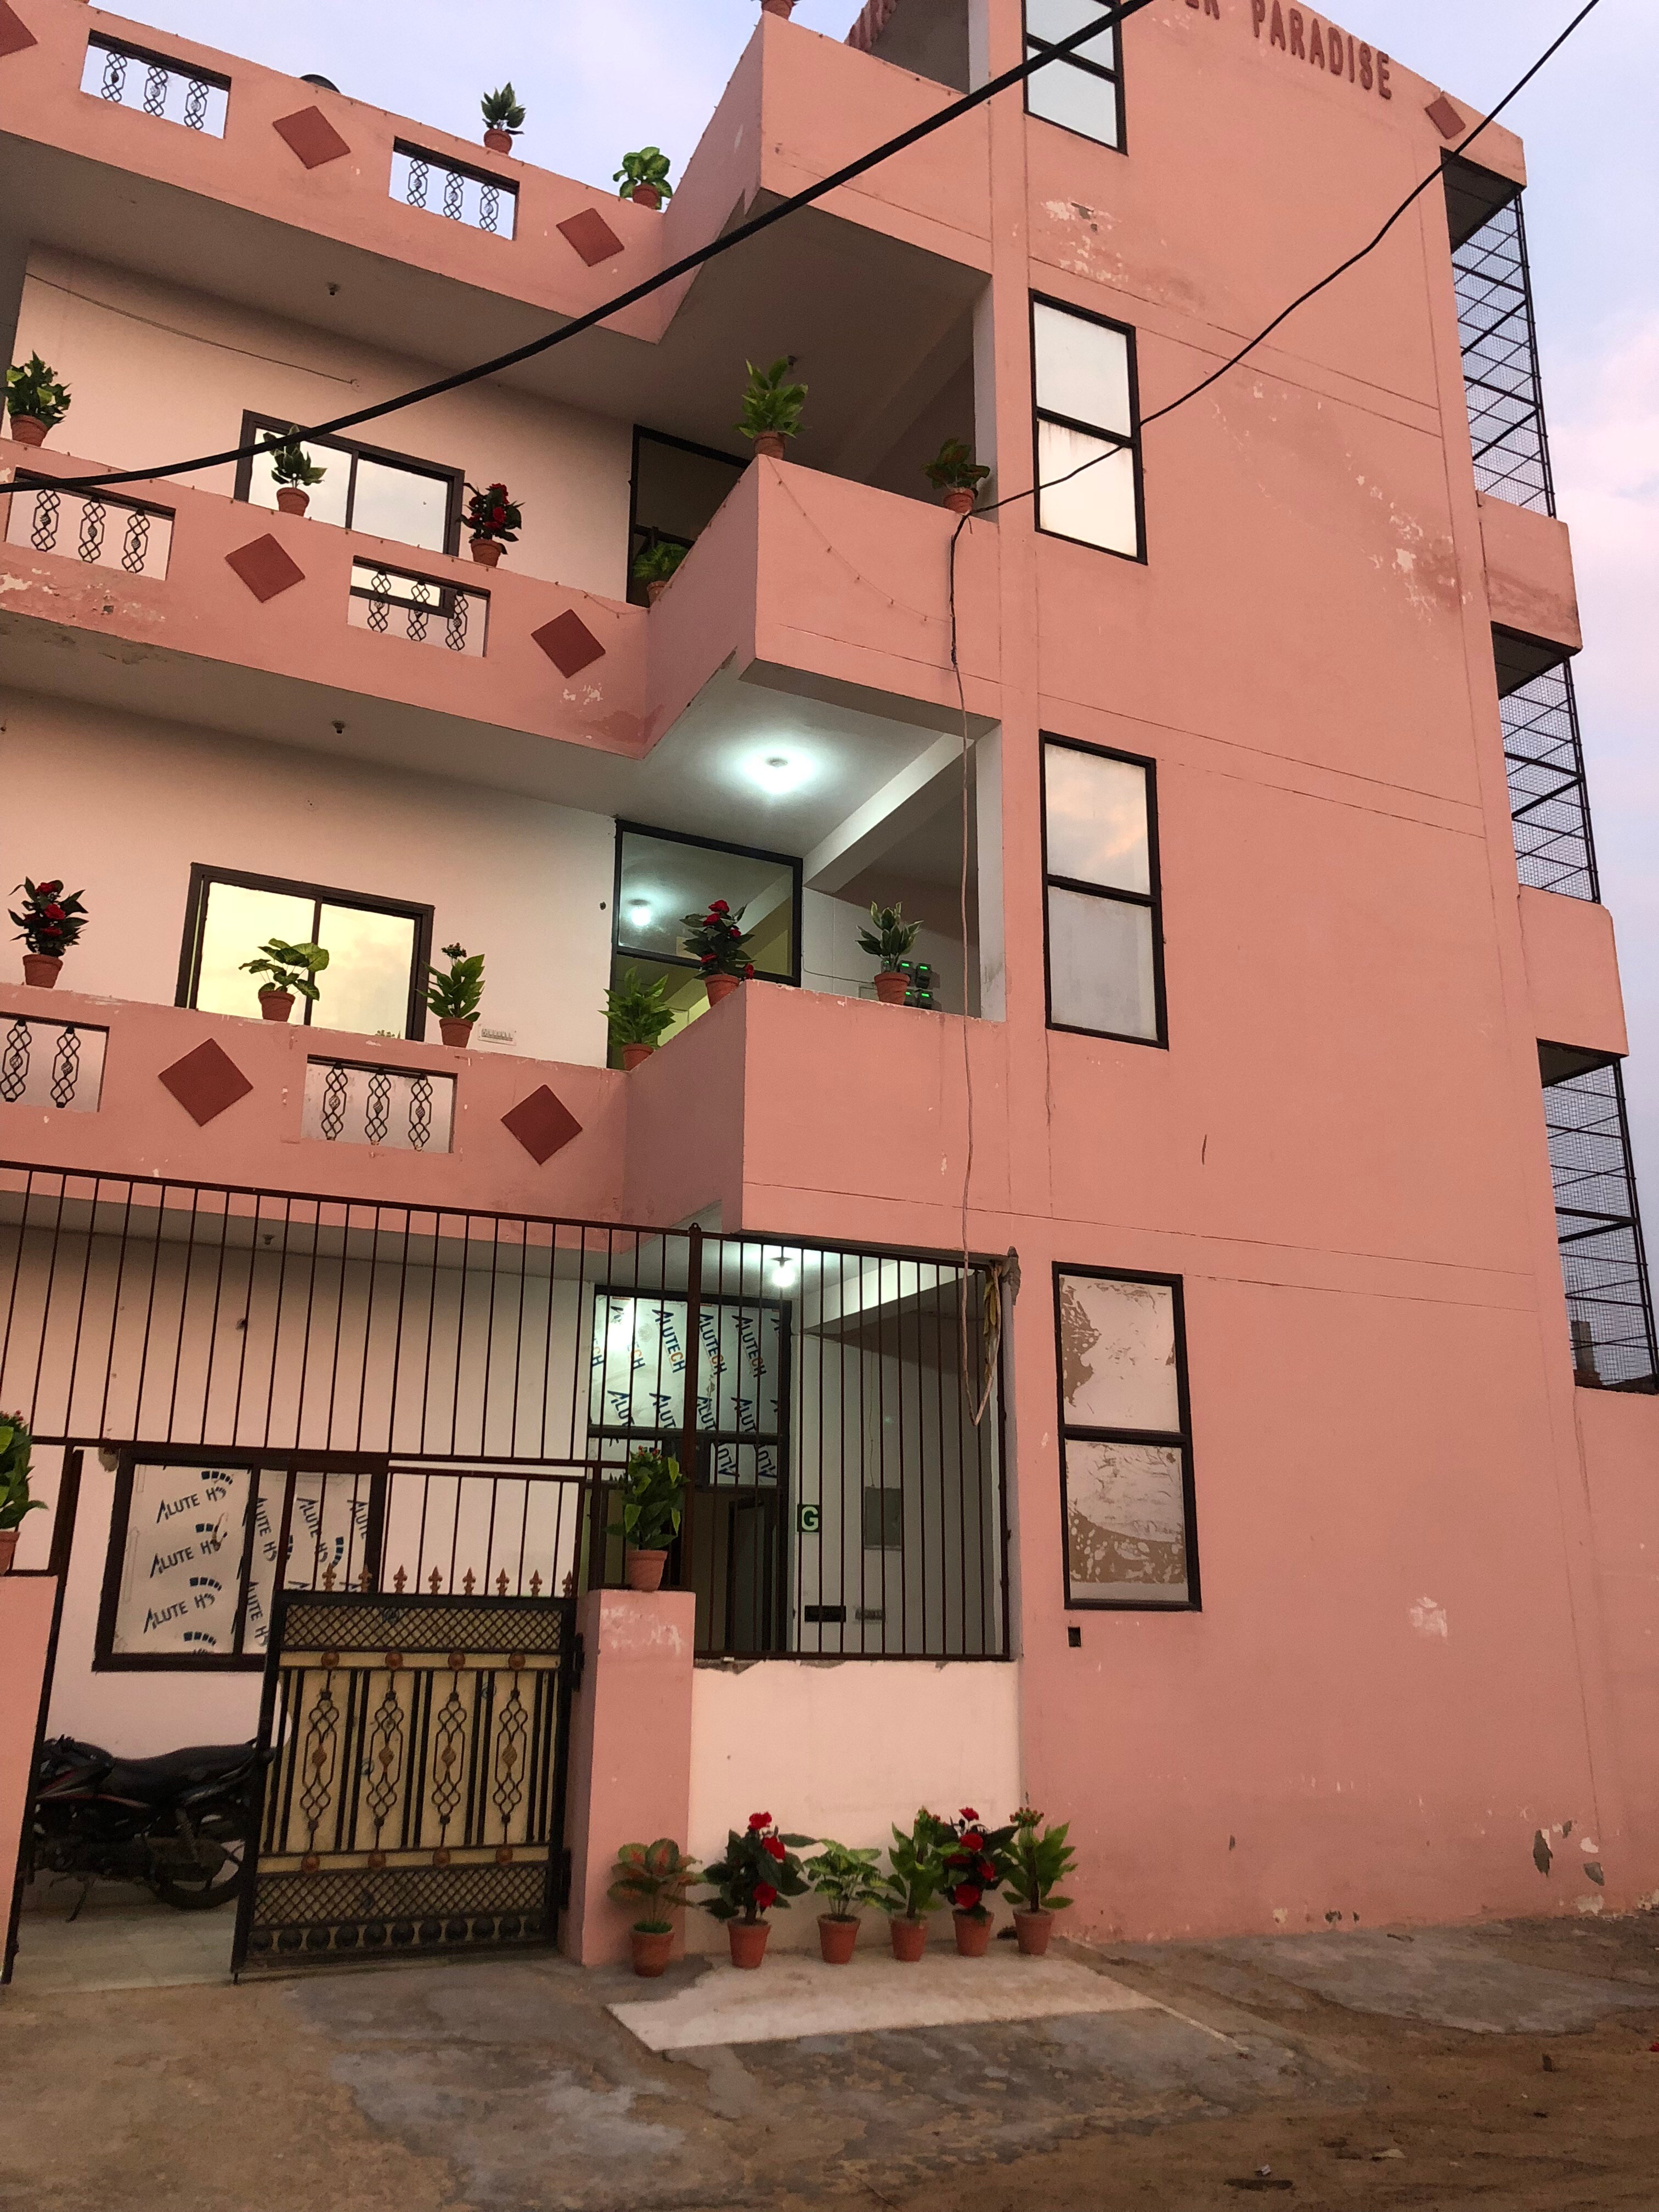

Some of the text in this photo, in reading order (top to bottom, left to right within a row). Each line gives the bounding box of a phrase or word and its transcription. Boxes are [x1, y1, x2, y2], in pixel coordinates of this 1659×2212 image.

[1251, 0, 1392, 100] PARADISE
[651, 1309, 686, 1373] ALUTECH
[699, 1313, 727, 1375] ALUTECH
[731, 1315, 767, 1378] ALUTECH
[802, 1506, 819, 1531] G
